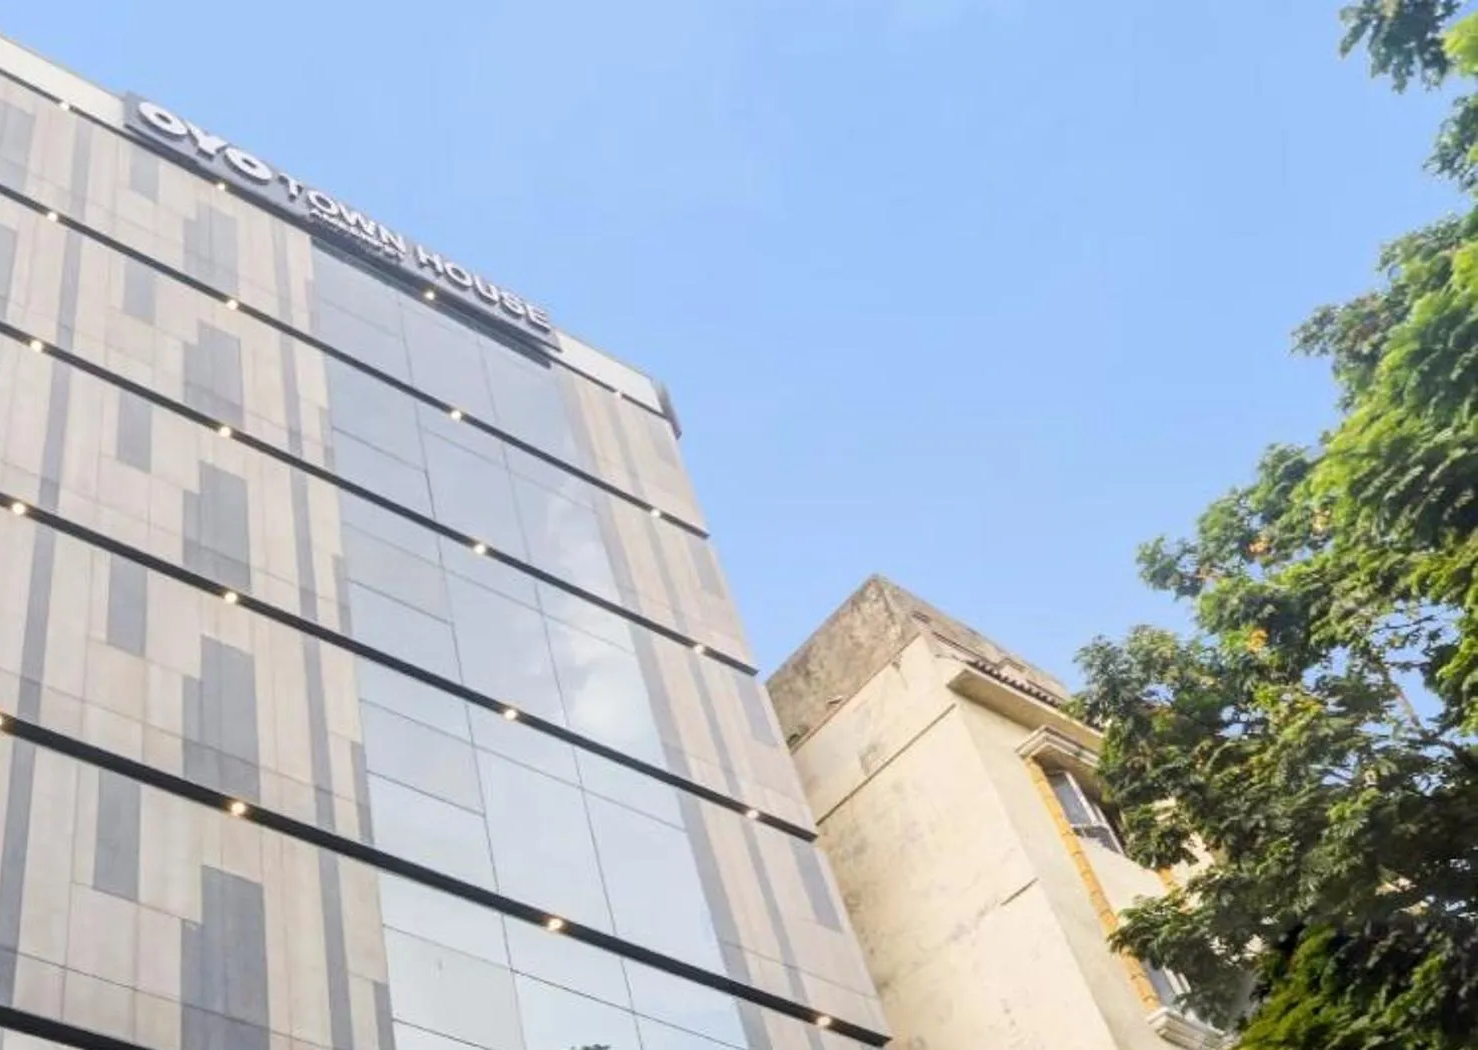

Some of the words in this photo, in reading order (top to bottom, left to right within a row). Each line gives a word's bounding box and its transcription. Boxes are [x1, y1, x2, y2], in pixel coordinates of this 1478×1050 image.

[138, 101, 273, 181] OYO
[278, 171, 407, 255] TOWN
[417, 244, 552, 330] HOUSE
